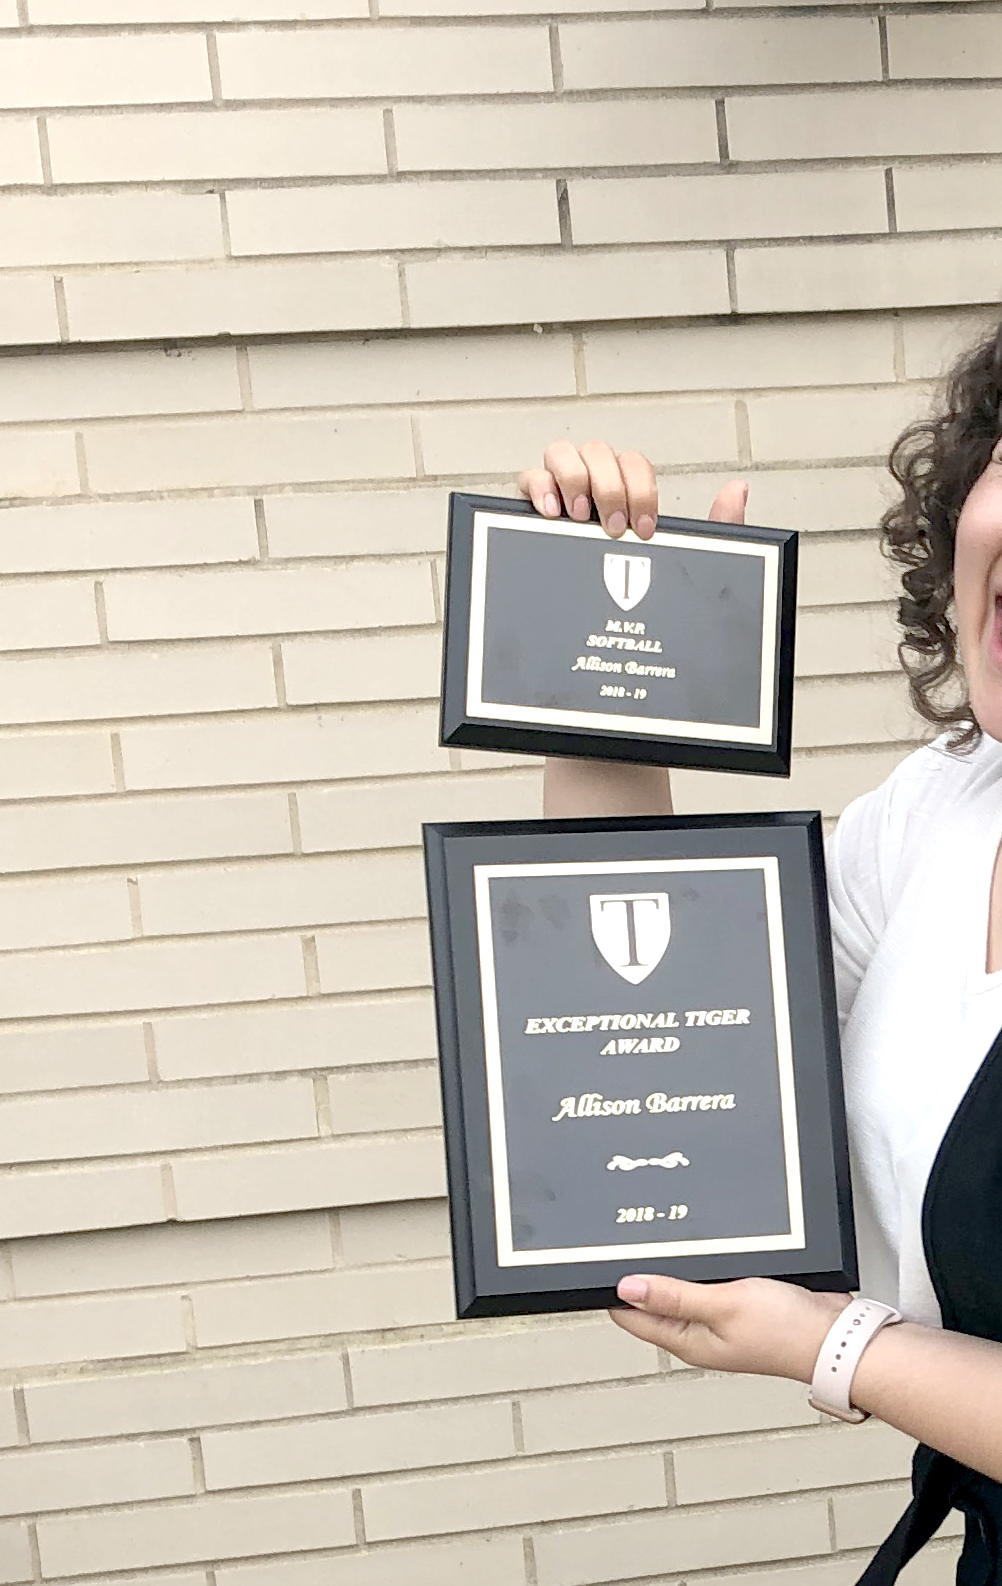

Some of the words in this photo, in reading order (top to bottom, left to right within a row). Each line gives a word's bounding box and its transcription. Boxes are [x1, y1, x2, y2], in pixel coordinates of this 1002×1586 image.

[586, 634, 662, 653] SOFTBALL
[571, 656, 622, 674] Allison
[624, 661, 676, 679] Barrera
[599, 684, 626, 698] 2018
[633, 688, 647, 700] 19
[600, 898, 659, 967] T
[524, 1012, 680, 1035] EXCEPTIONAL
[684, 1008, 750, 1027] TIGER
[599, 1036, 681, 1056] AWARD
[552, 1092, 641, 1122] Allison
[645, 1092, 737, 1114] Barrera
[615, 1206, 655, 1223] 2018
[667, 1204, 689, 1220] 19
